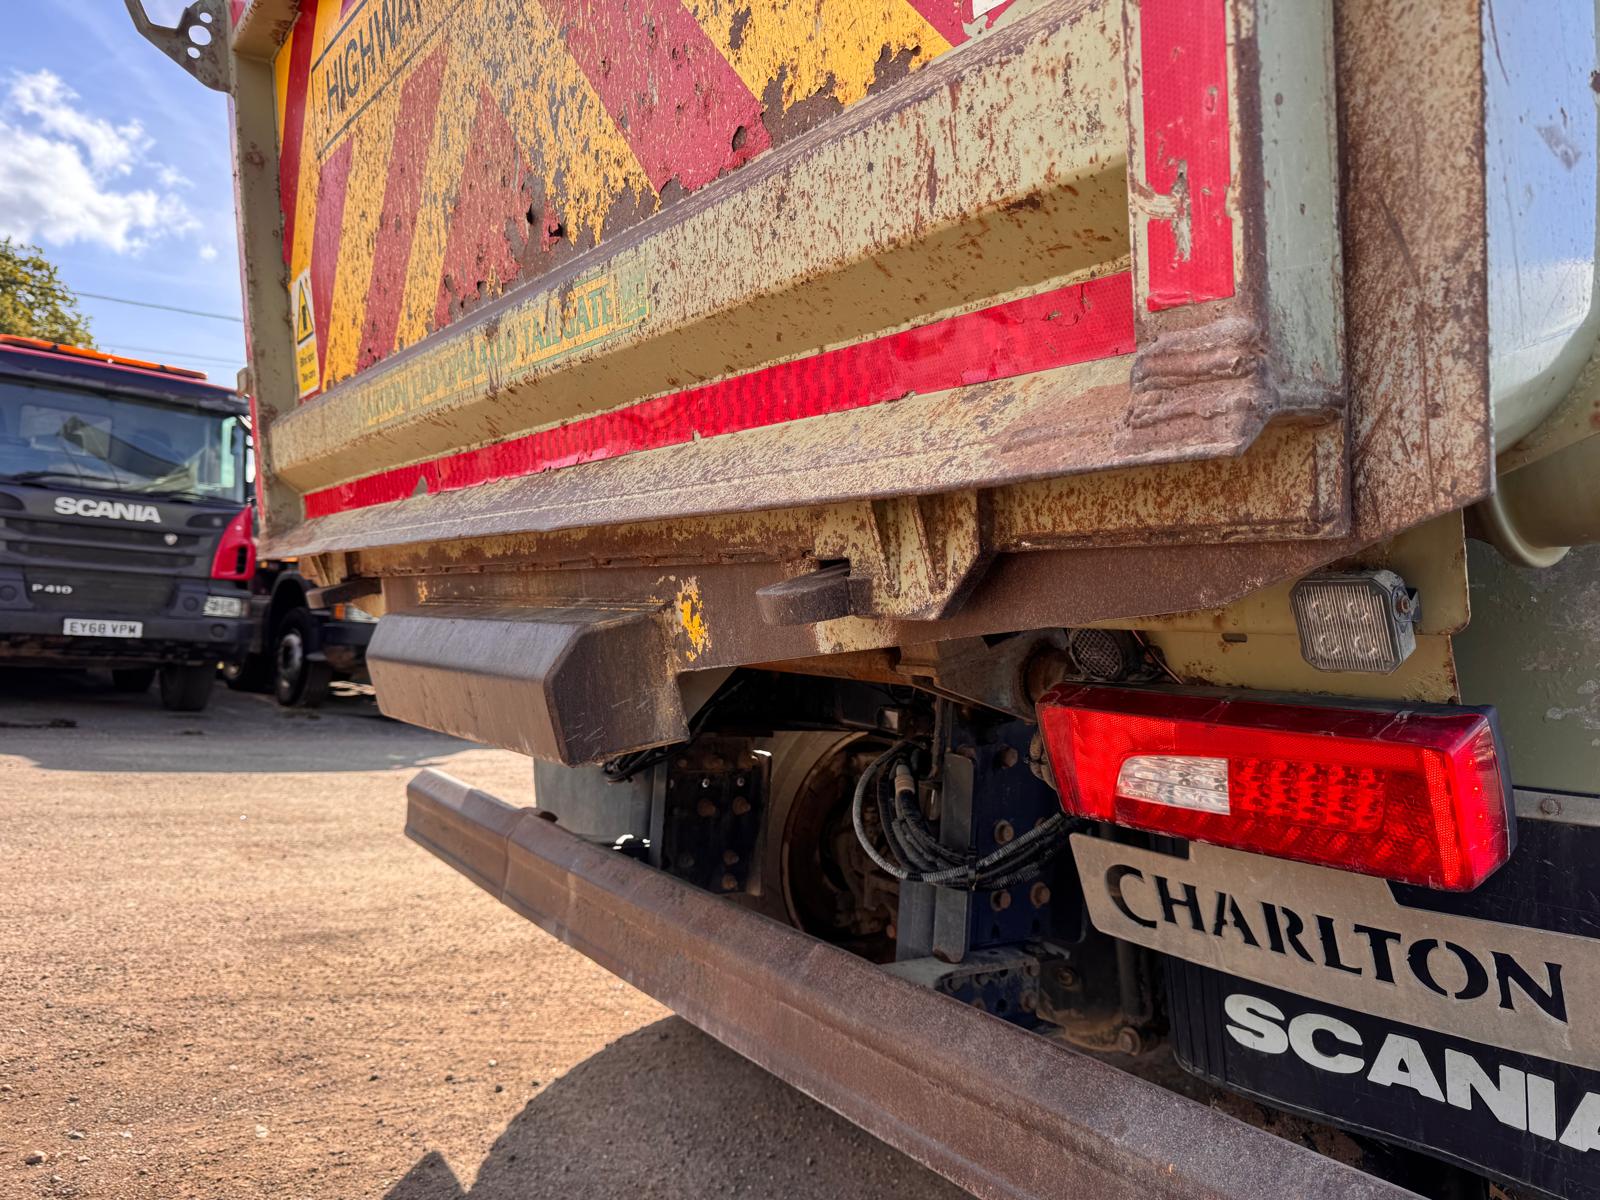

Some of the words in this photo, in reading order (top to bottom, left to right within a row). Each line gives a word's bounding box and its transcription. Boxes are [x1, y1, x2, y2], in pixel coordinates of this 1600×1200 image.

[523, 284, 613, 354] TAILGATE
[54, 496, 161, 523] SCANIA
[32, 583, 43, 592] P
[44, 585, 73, 594] 410
[1105, 864, 1568, 1025] CHARLTON
